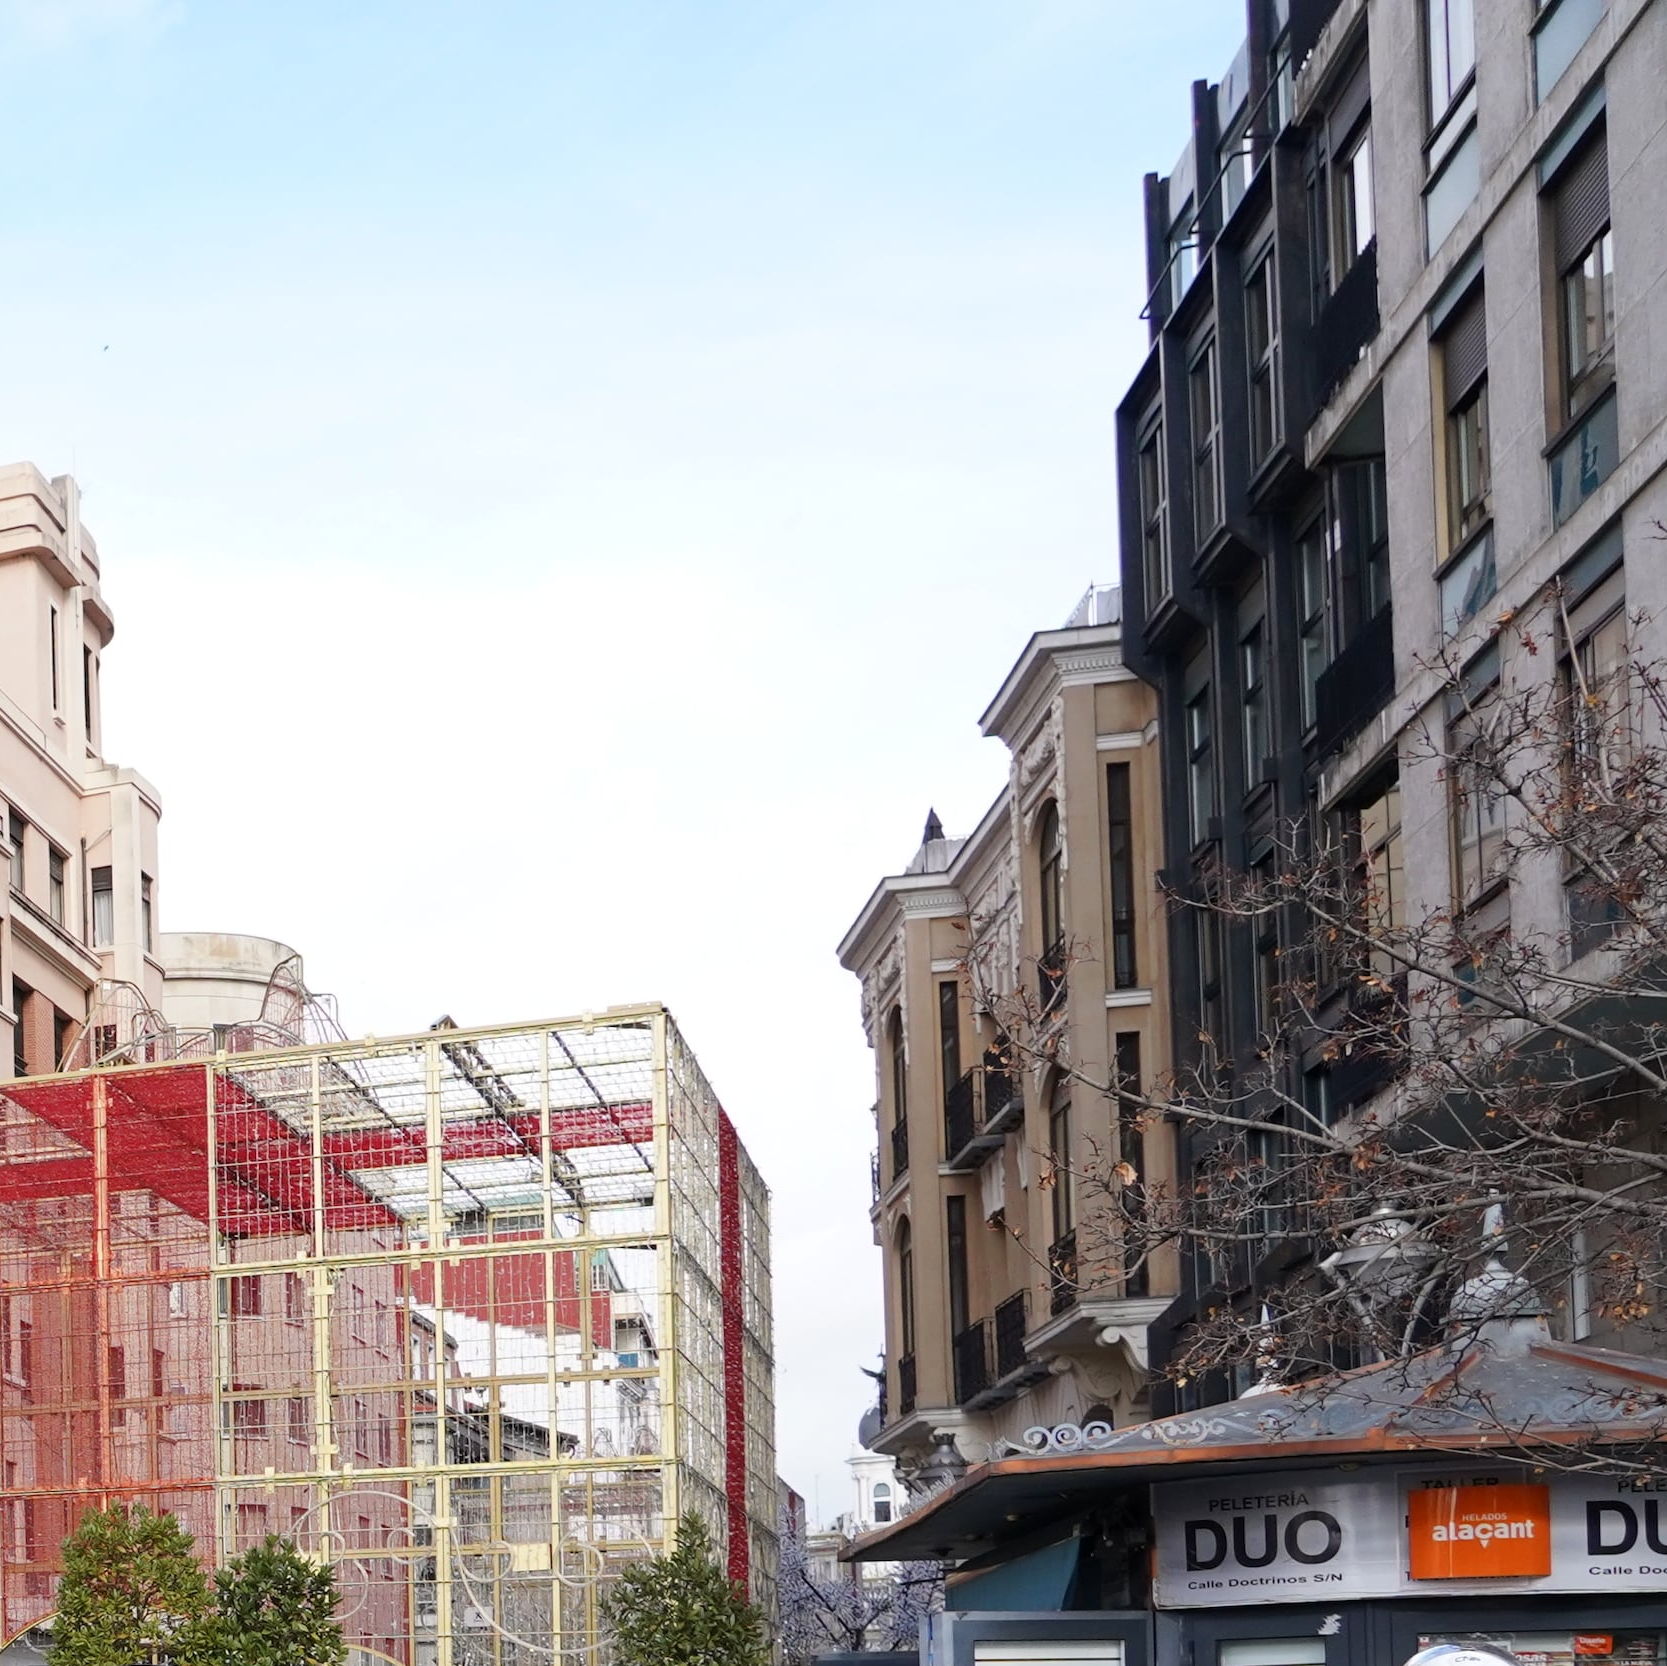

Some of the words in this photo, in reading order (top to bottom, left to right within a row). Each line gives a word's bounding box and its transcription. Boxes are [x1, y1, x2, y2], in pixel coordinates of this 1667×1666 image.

[1209, 1490, 1310, 1512] PELETERÍA
[1462, 1512, 1508, 1522] HELADOS
[1184, 1510, 1343, 1572] DUO
[1588, 1566, 1633, 1576] Calle
[1188, 1579, 1224, 1591] Calle
[1228, 1574, 1308, 1588] Doctrinos
[1313, 1573, 1344, 1583] S/N
